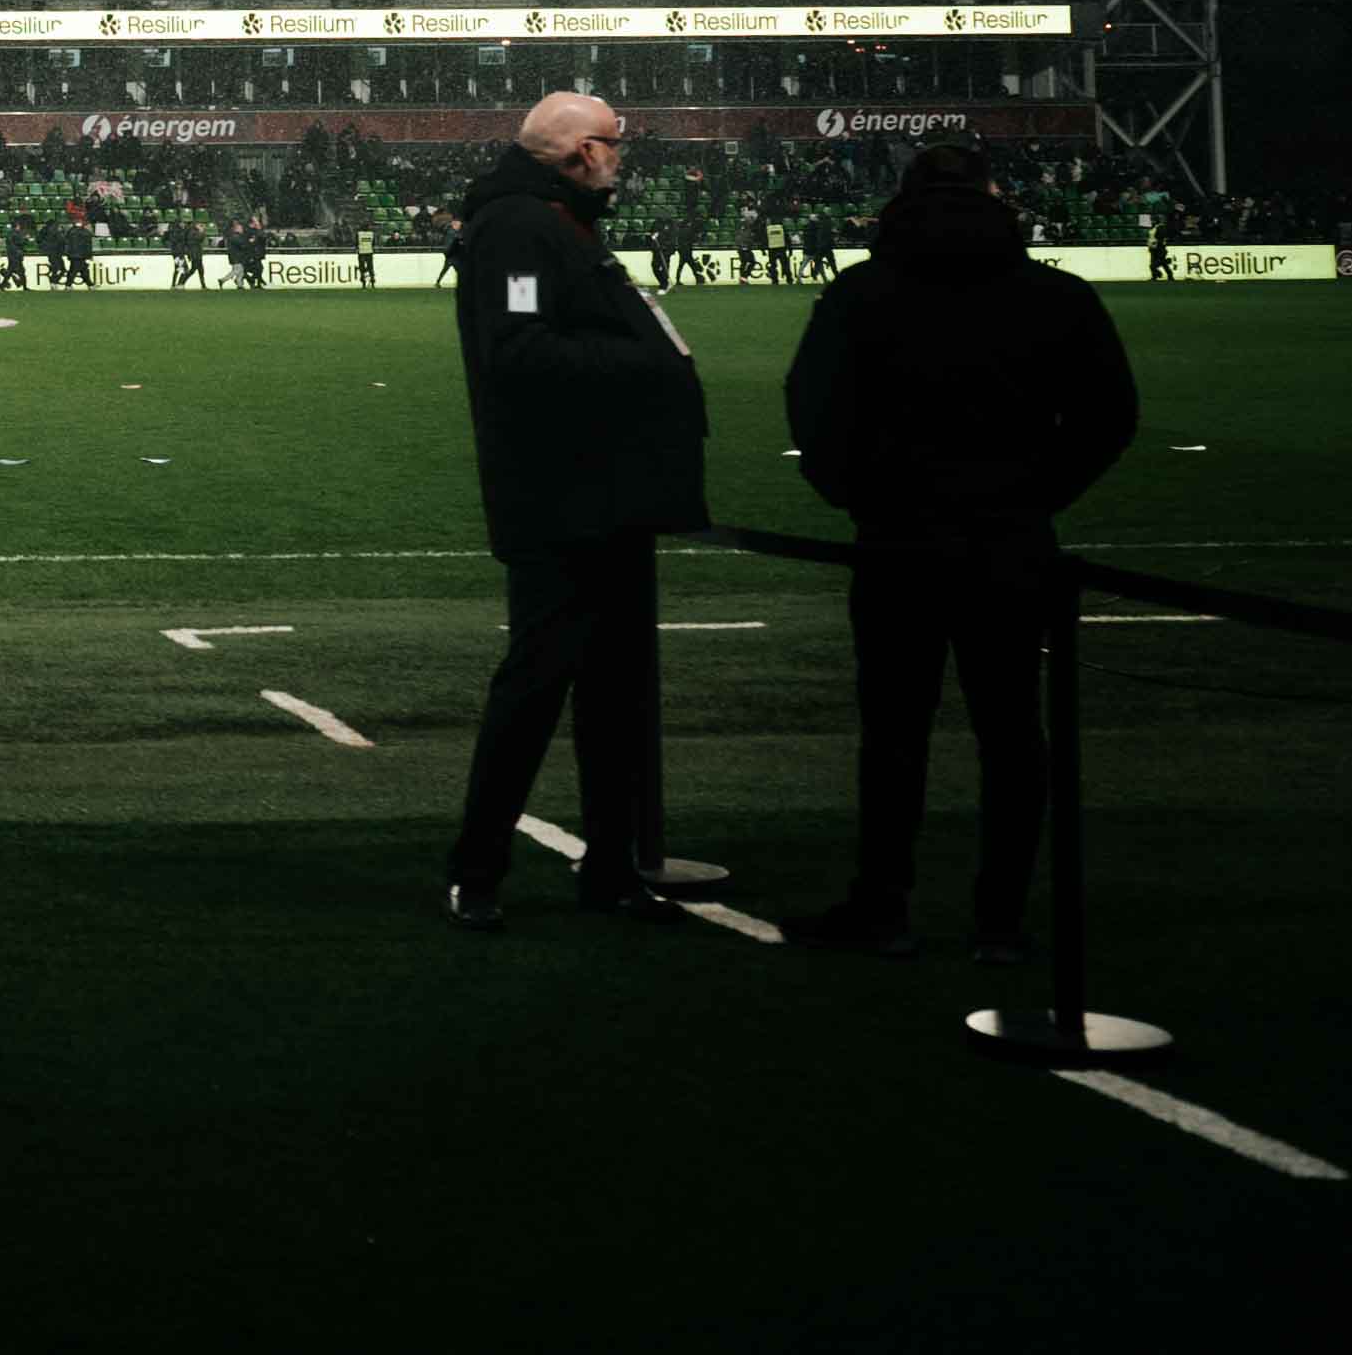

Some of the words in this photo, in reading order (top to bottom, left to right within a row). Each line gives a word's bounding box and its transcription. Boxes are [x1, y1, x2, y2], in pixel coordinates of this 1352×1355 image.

[269, 14, 355, 33] Resilium
[693, 12, 779, 31] Resilium
[116, 115, 236, 142] énergem
